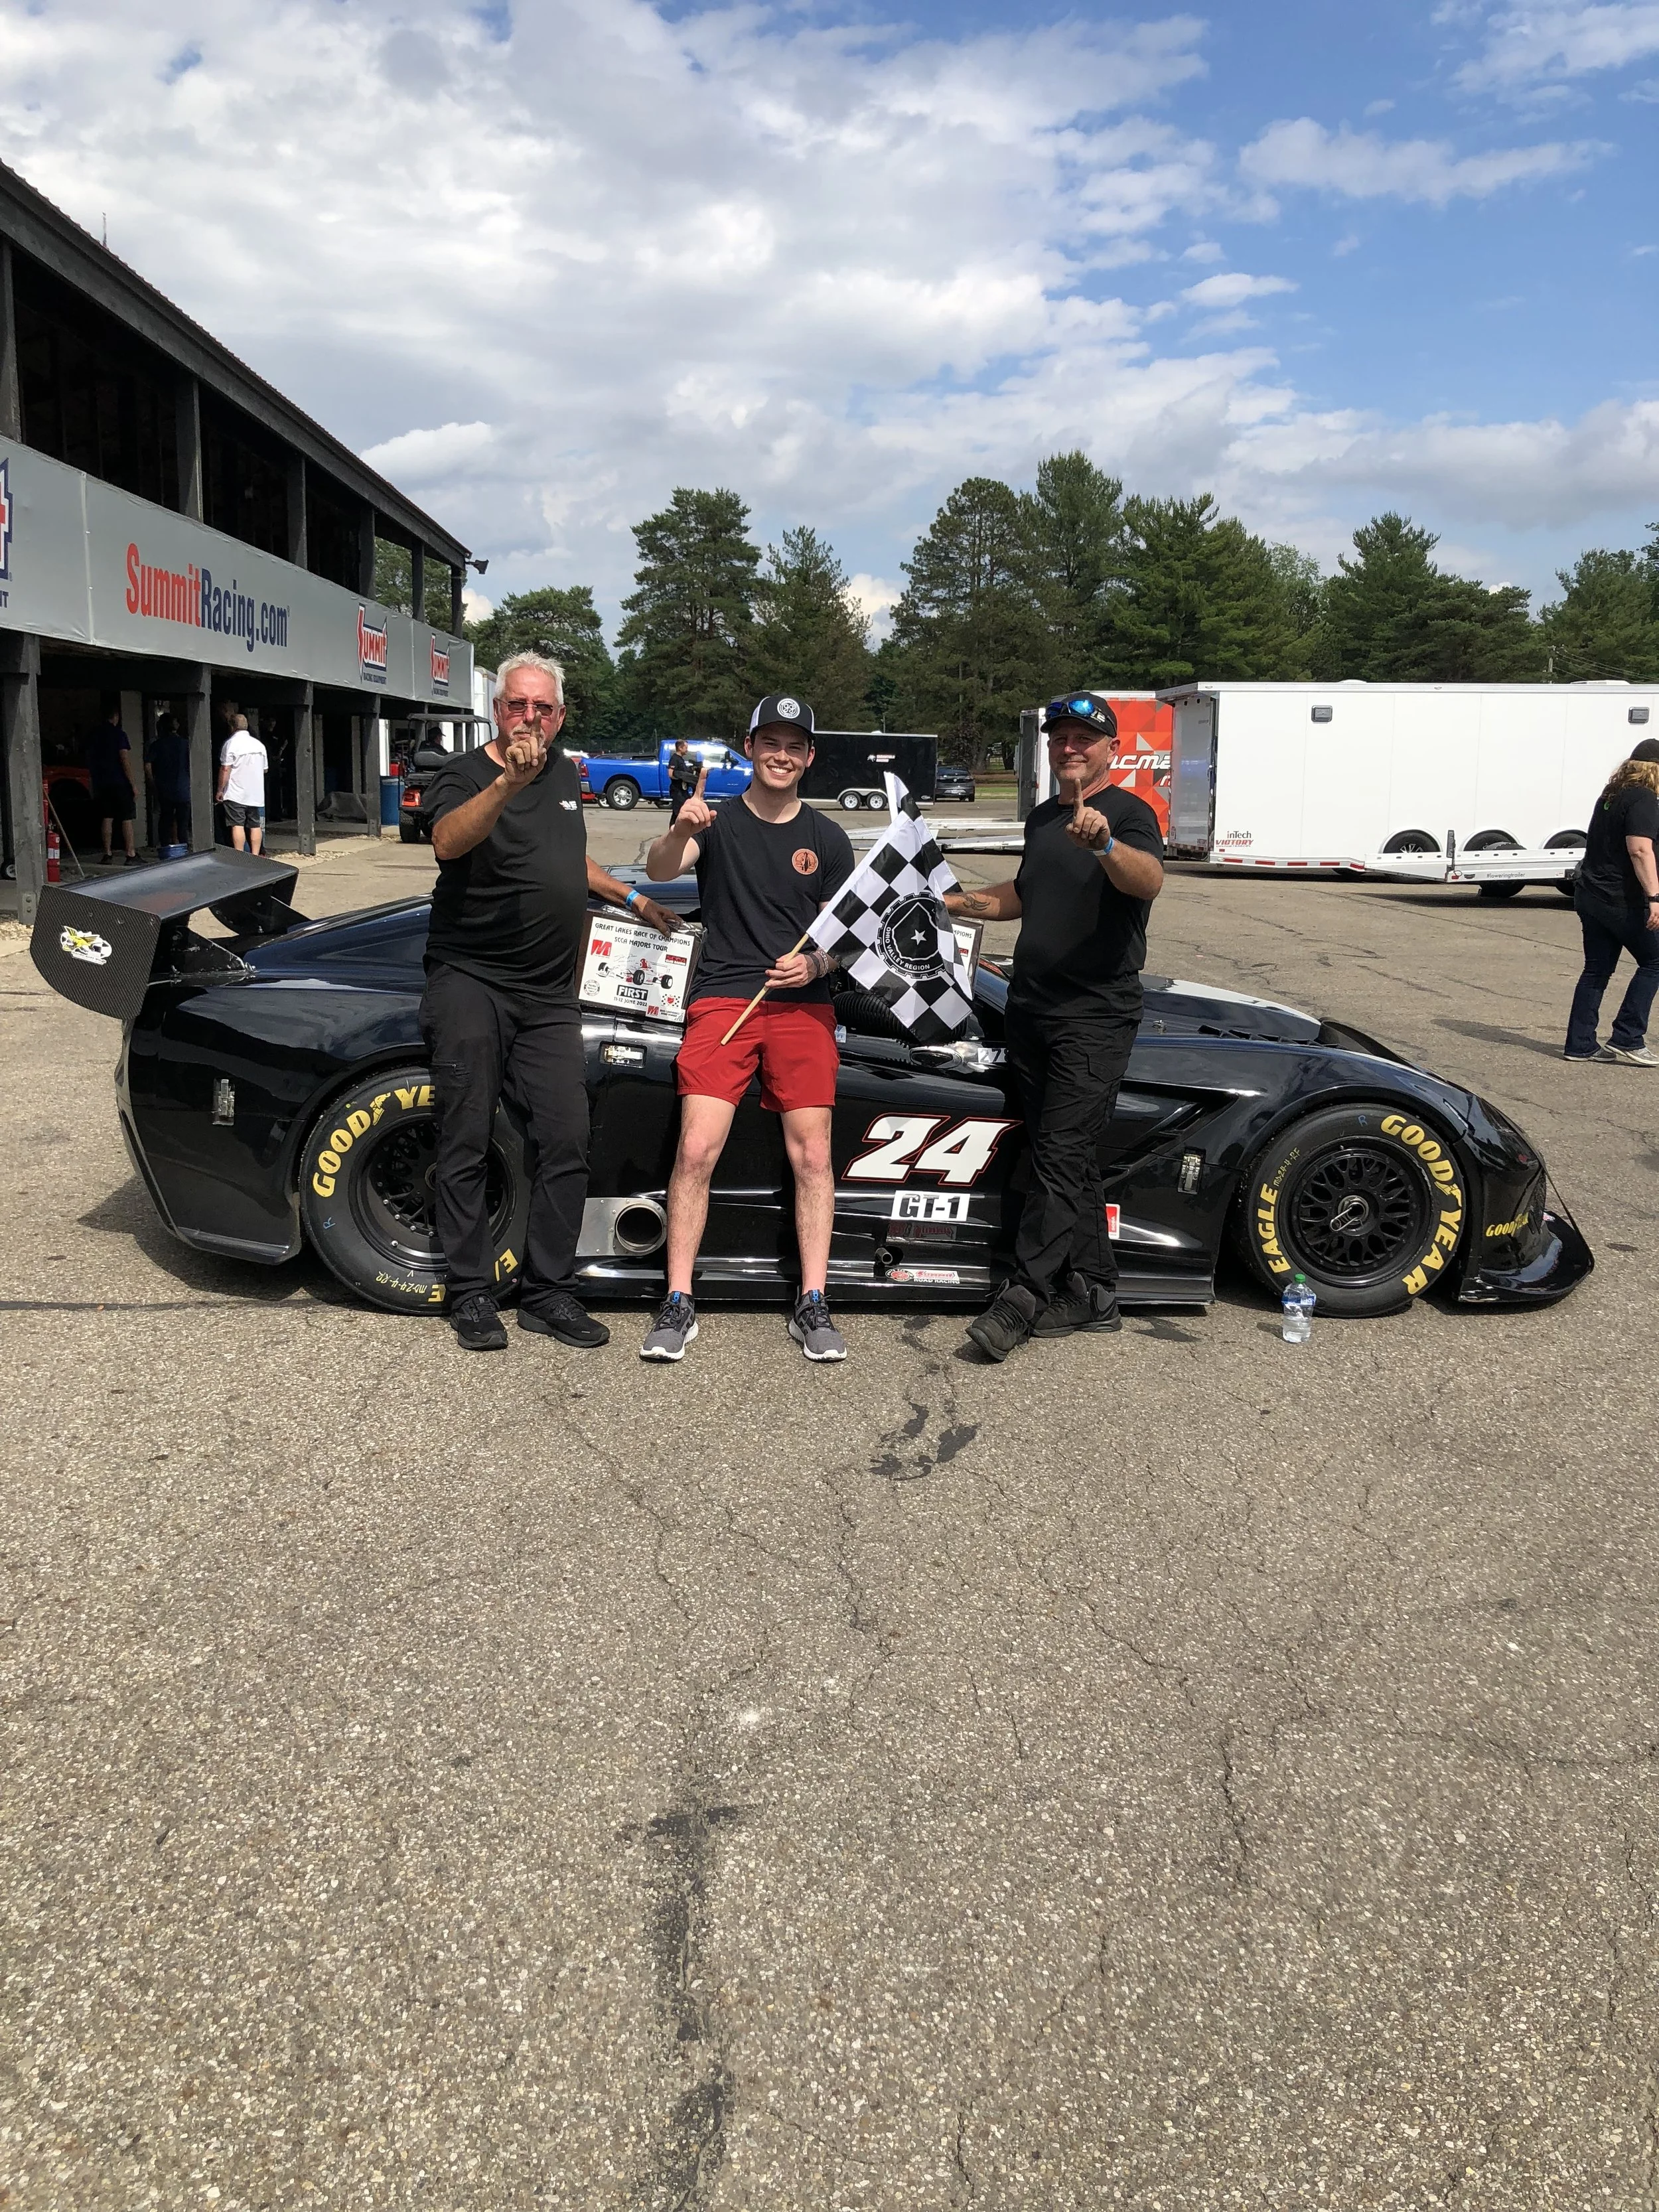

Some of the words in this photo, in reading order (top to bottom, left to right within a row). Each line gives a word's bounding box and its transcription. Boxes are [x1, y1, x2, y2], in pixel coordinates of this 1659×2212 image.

[126, 543, 287, 652] SummitRacing.com
[358, 603, 388, 683] SUMMIT
[431, 633, 450, 694] SUMMIT
[595, 922, 614, 931] GREAT
[658, 934, 691, 946] CHAMPIONS
[629, 939, 651, 948] MAJORS
[652, 943, 668, 952] TOUR
[886, 944, 904, 966] VALLEY
[618, 986, 648, 999] FIRST
[841, 1113, 1023, 1187] 24
[899, 1194, 961, 1218] GT-1
[1258, 1183, 1291, 1274] EAGLE
[1380, 1114, 1463, 1295] GOODYEAR
